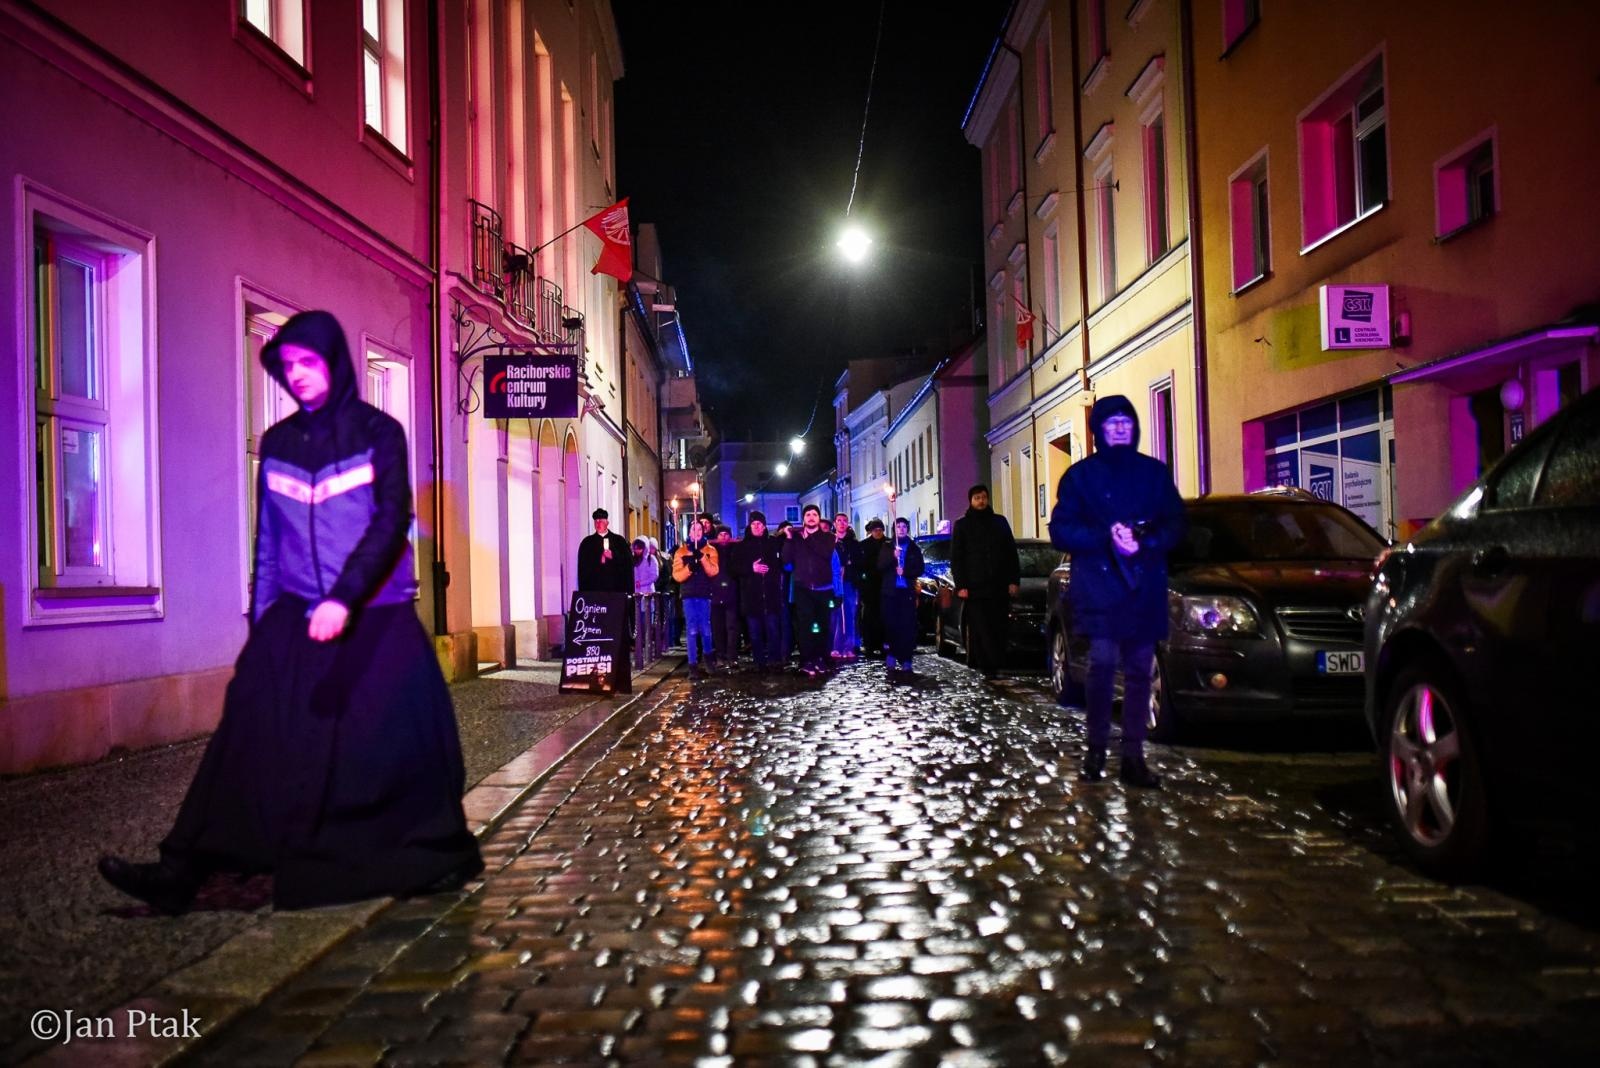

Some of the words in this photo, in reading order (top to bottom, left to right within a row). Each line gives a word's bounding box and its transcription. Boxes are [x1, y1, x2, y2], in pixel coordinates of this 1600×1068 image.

[1344, 299, 1372, 312] CSK
[506, 364, 571, 379] Raciborskie
[507, 394, 547, 410] Kultury
[1512, 424, 1523, 441] 14
[575, 597, 607, 620] Ogniem
[573, 620, 602, 639] Dymem
[566, 656, 600, 664] POSTAW
[1328, 653, 1361, 671] SWD
